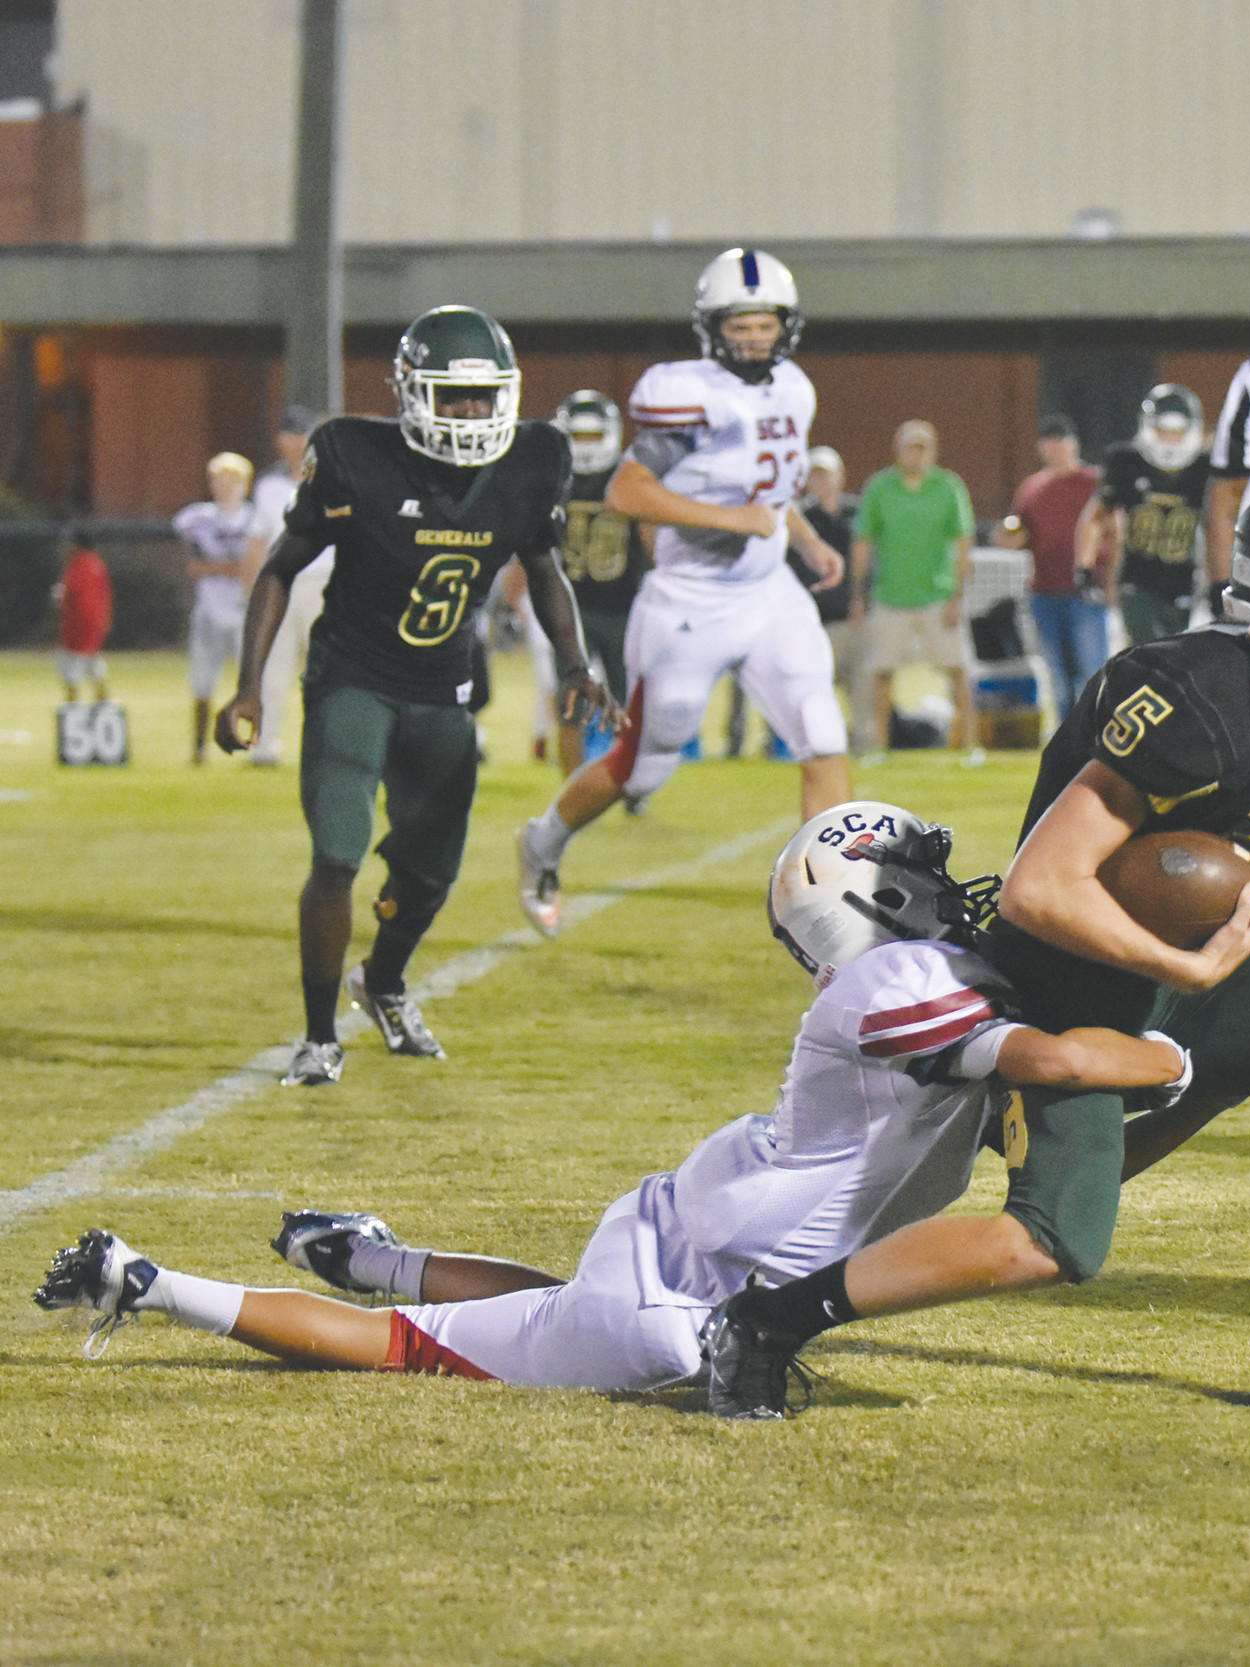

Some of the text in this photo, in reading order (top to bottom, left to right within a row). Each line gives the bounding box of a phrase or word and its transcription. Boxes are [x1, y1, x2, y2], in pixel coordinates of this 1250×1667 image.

[757, 417, 797, 439] SCA
[415, 529, 494, 546] GENERALS
[63, 704, 126, 761] 50
[1102, 684, 1174, 757] 5
[818, 813, 898, 847] SCA
